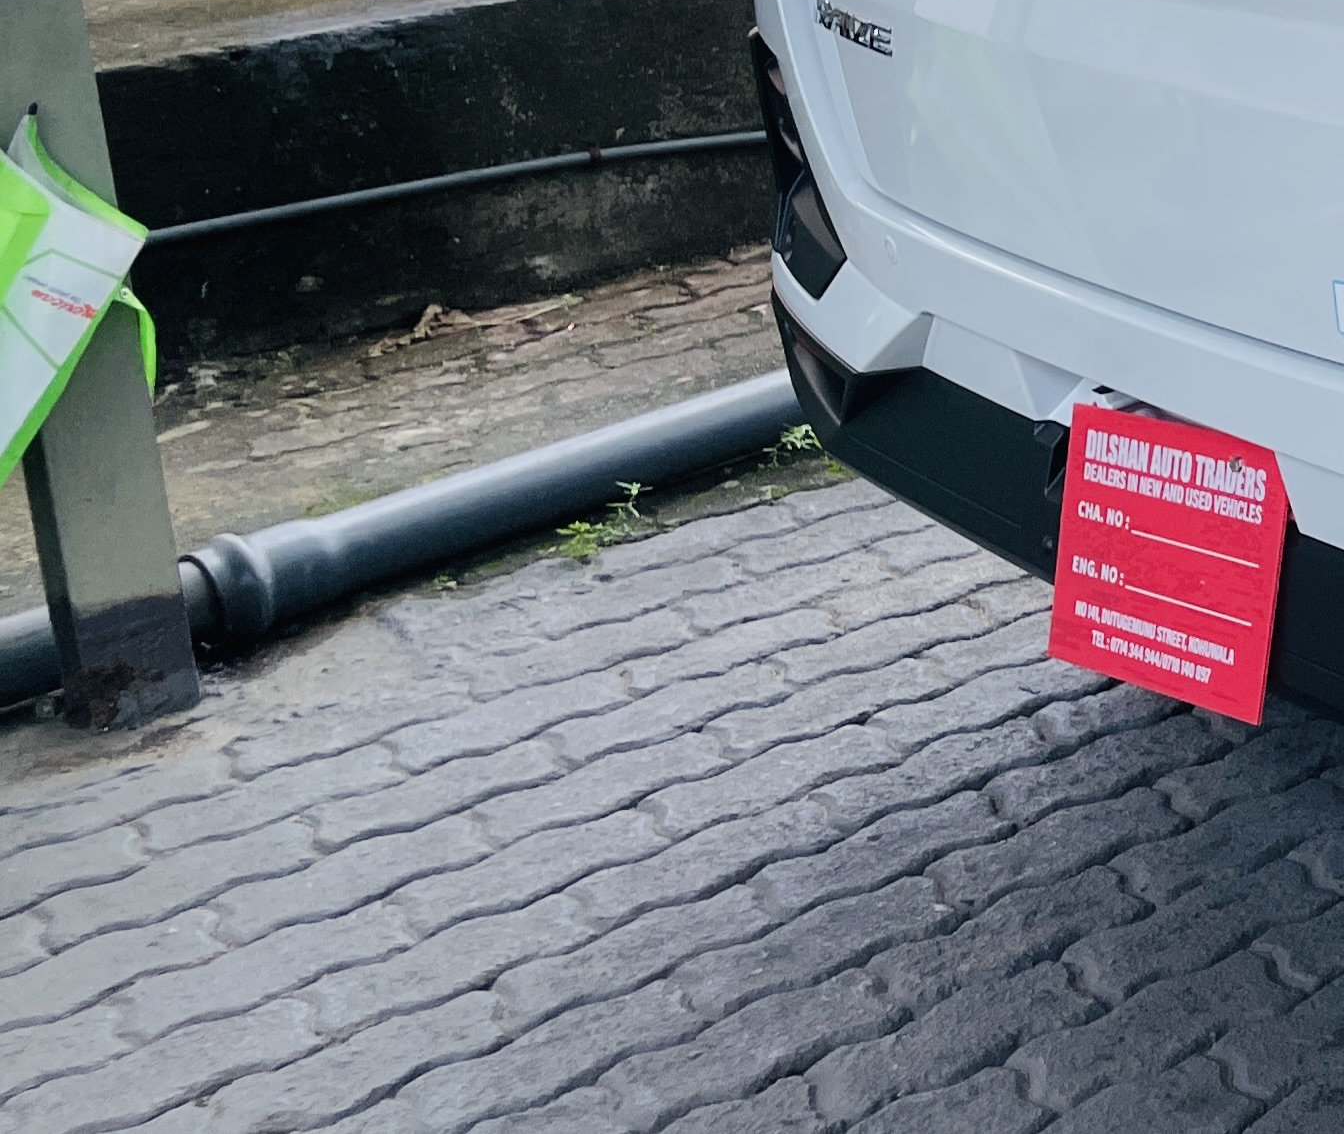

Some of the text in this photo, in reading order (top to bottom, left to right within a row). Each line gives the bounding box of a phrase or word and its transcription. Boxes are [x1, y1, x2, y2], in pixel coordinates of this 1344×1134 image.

[1084, 428, 1267, 502] DILSHAN AUTO TRADERS
[1083, 461, 1263, 525] DEALERS IN NEW AND USED VEHICLES
[1077, 500, 1104, 523] CHA.
[1072, 555, 1099, 578] ENG.
[1156, 625, 1188, 653] STREET,
[1128, 642, 1145, 662] 344
